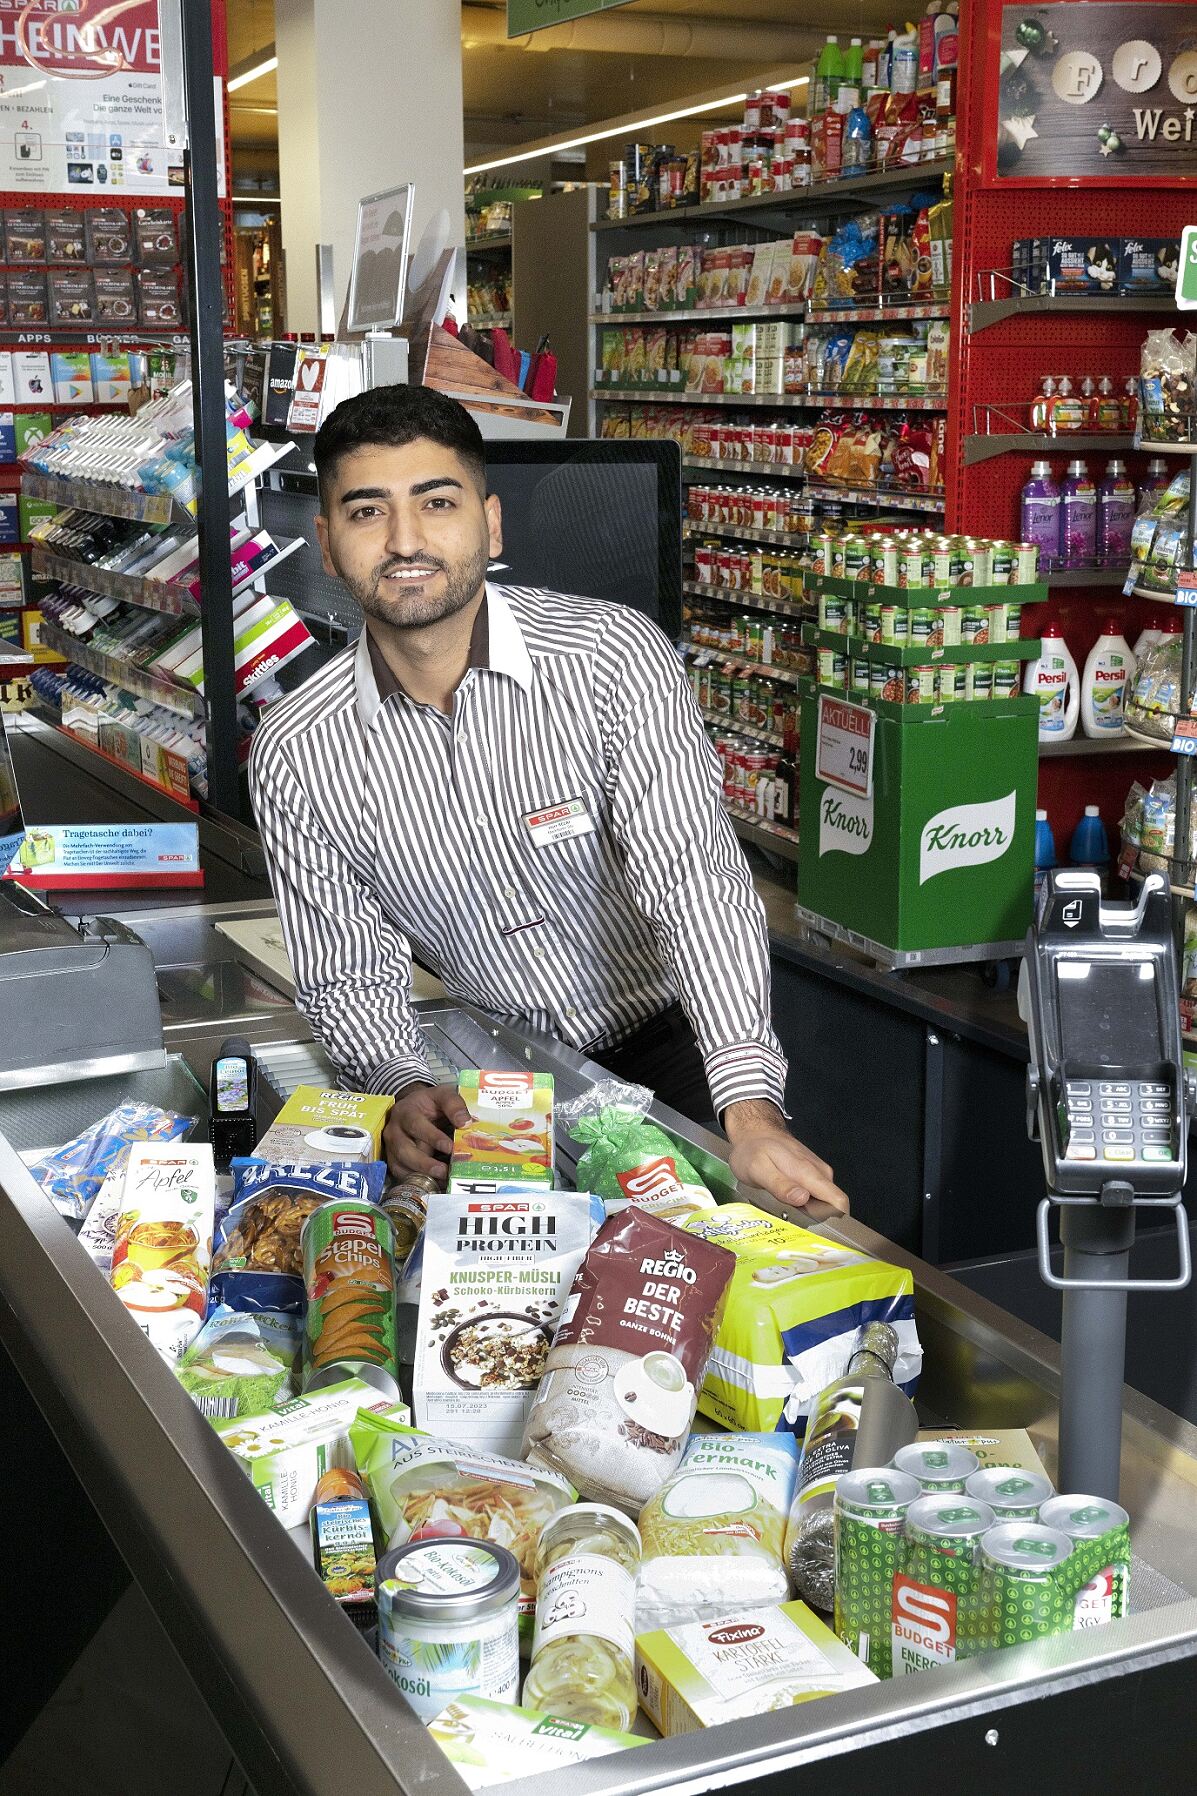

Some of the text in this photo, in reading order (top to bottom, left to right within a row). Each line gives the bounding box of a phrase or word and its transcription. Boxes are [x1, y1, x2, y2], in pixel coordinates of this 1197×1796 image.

[0, 1, 57, 11] SPAR
[103, 94, 120, 102] Eine
[16, 105, 54, 114] BEZAHLEN
[93, 103, 106, 112] Die
[108, 105, 132, 113] ganze
[18, 334, 51, 343] APPS
[1033, 513, 1054, 524] Lenor
[1072, 511, 1093, 522] Lenor
[1109, 510, 1131, 521] Lenor
[1177, 591, 1197, 605] BIO
[1037, 671, 1067, 685] Persil
[1095, 669, 1126, 682] Persil
[1173, 739, 1195, 752] BIO
[849, 746, 869, 774] 2,99
[537, 808, 570, 823] SPAR
[823, 798, 871, 840] Knorr
[63, 829, 153, 840] Tragetasche dabei?
[926, 823, 1008, 852] Knorr
[1105, 1085, 1113, 1093] 2
[320, 1091, 366, 1103] REGIO
[301, 1105, 325, 1114] BIS
[135, 1168, 194, 1191] Apfel
[631, 1183, 685, 1203] BUDGET
[480, 1203, 529, 1211] SPAR
[457, 1216, 557, 1236] HIGH
[319, 1239, 383, 1265] Stapel
[455, 1239, 557, 1252] PROTEIN
[335, 1249, 381, 1269] Chips
[450, 1268, 561, 1284] KNUSPER-MÜSLI
[639, 1258, 698, 1285] REGIO
[453, 1285, 556, 1296] Schoko-Kürbiskern
[642, 1281, 682, 1306] DER
[624, 1297, 685, 1333] BESTE
[619, 1319, 677, 1346] GANZE BOHNE
[259, 1399, 350, 1432] KAMILLE-HONIG
[276, 1401, 305, 1416] Vital
[700, 1442, 745, 1452] Bio-
[826, 1444, 850, 1453] OLIVA
[393, 1451, 423, 1470] AUS
[428, 1446, 523, 1469] STEIRISCHEN
[281, 1471, 290, 1512] KAMILLE
[289, 1470, 298, 1504] HONIG
[322, 1525, 369, 1534] Kürbis-
[325, 1532, 367, 1542] kernöl
[423, 1550, 476, 1587] Bio-Kokosöl
[711, 1626, 762, 1643] Fixina
[894, 1624, 953, 1659] BUDGET
[713, 1638, 786, 1665] KARTOFFEL
[537, 1724, 583, 1740] Vital
